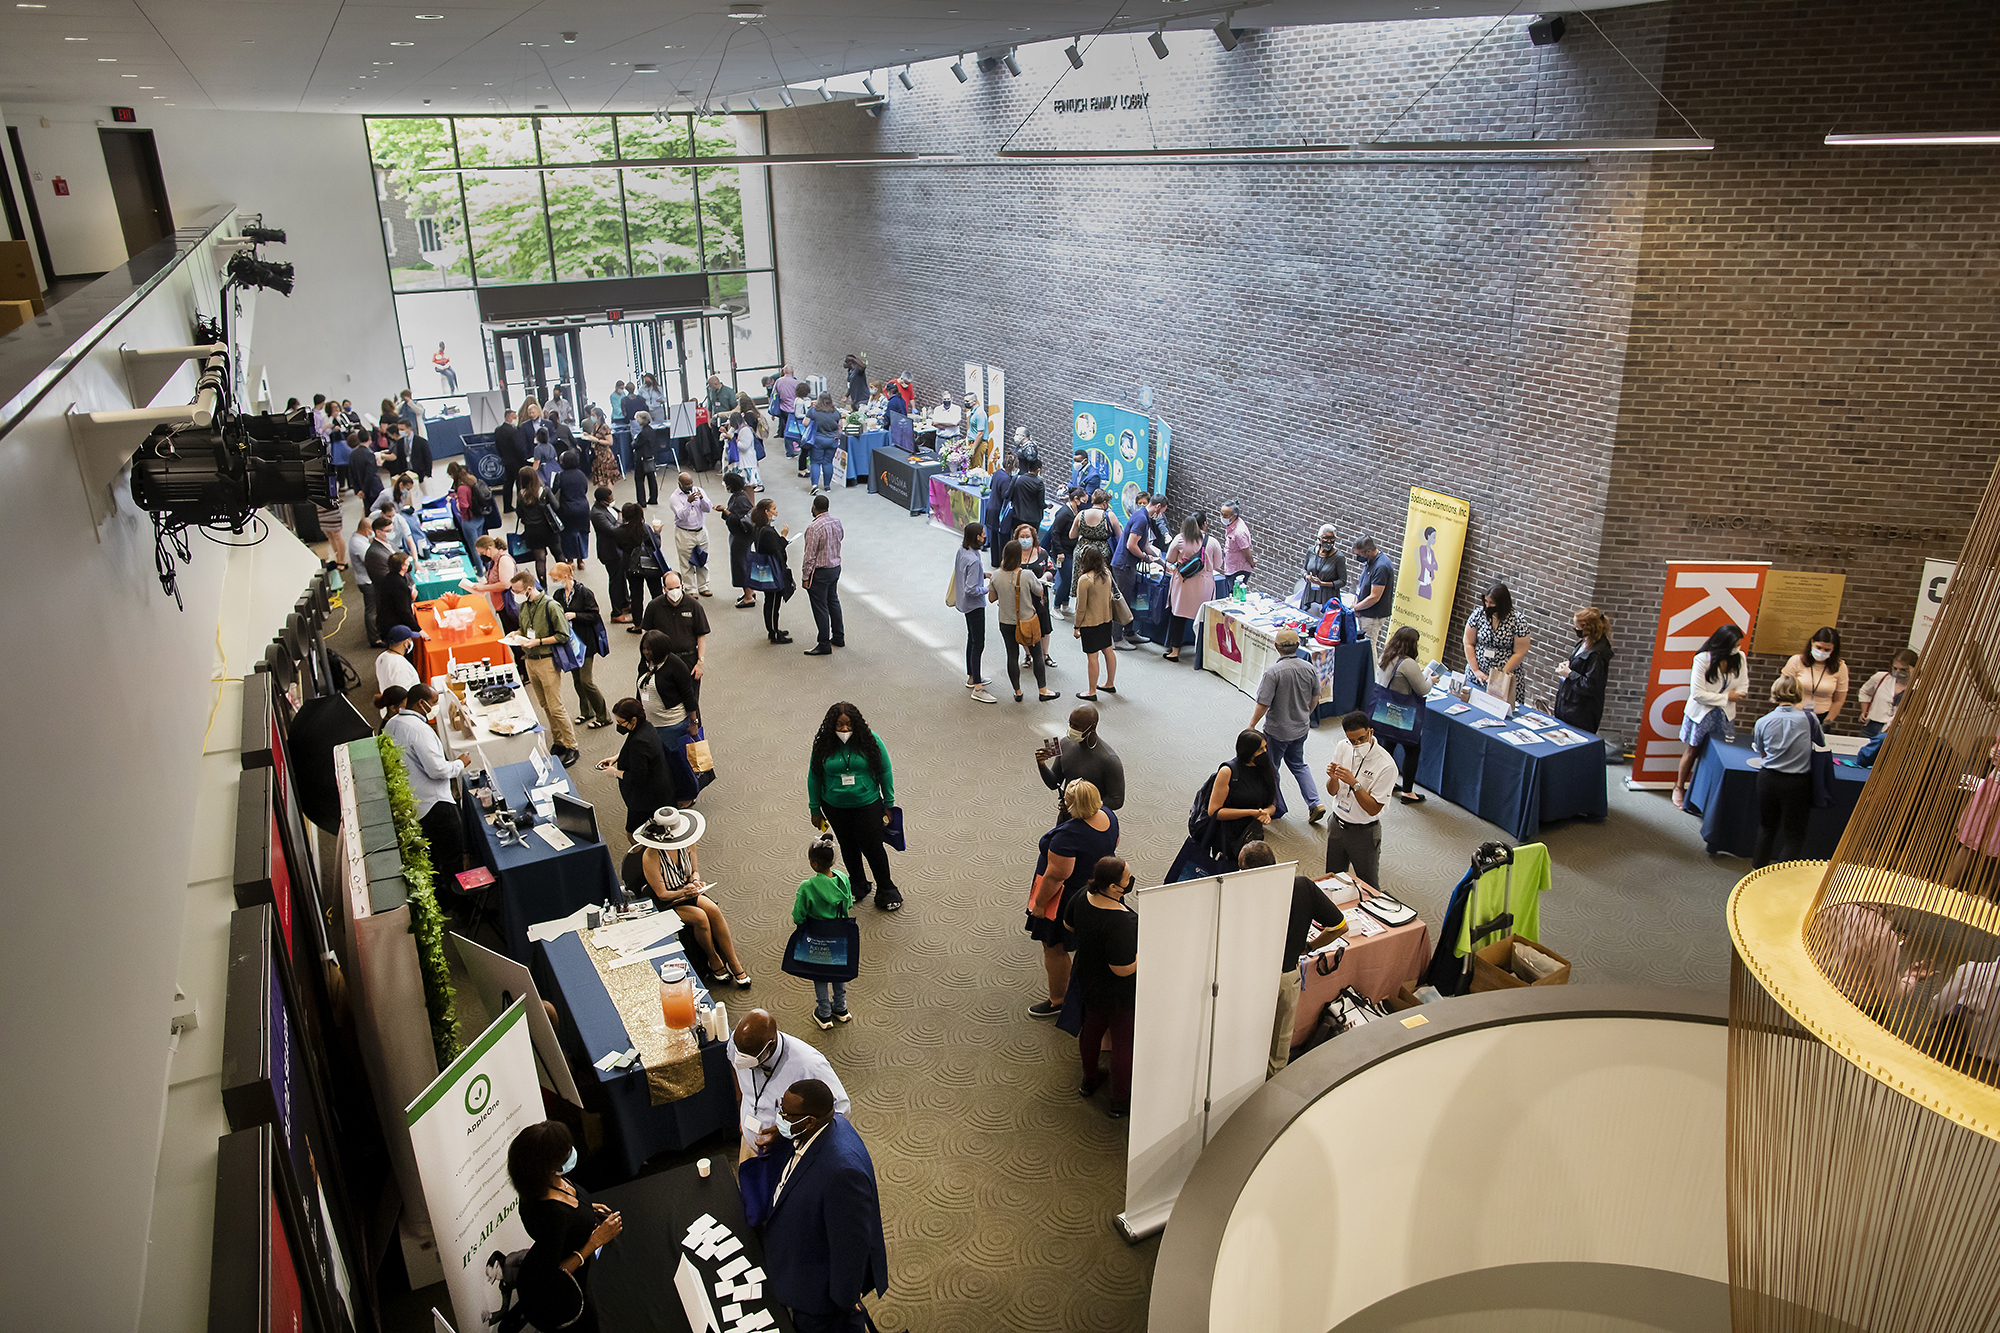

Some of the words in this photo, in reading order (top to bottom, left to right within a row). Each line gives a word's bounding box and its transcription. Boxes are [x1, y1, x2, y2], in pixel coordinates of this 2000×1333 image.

[1090, 94, 1118, 111] FAMILY
[1120, 92, 1149, 109] LOBBY
[118, 108, 132, 121] EXIT
[609, 310, 621, 320] EXIT
[1689, 513, 1774, 531] HAROLD
[1806, 519, 1949, 541] ZELLERBACH
[1765, 541, 1858, 560] THEATRE
[1395, 605, 1420, 621] Marketing
[1420, 614, 1433, 626] Tools
[466, 1099, 500, 1137] AppleOne
[472, 1134, 492, 1156] Personal
[474, 1157, 491, 1175] Search
[491, 1146, 501, 1158] Plan
[506, 1125, 521, 1142] Action
[459, 1186, 482, 1218] Customized
[479, 1190, 500, 1212] Interview
[462, 1243, 477, 1270] It's
[479, 1220, 494, 1248] All
[495, 1196, 519, 1229] Abou
